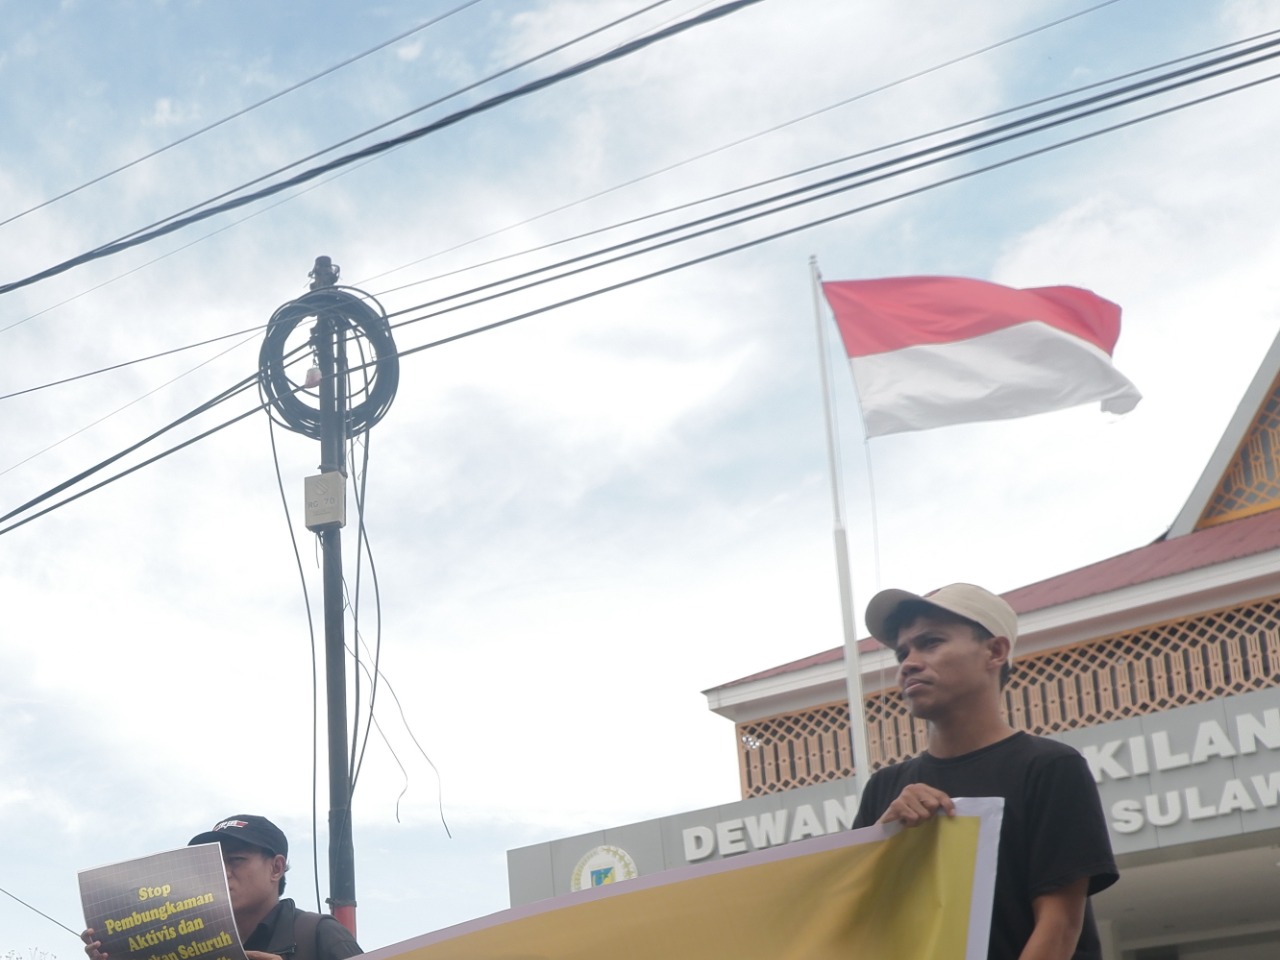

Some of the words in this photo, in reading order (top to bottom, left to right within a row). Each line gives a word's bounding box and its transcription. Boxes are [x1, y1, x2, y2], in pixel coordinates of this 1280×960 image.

[682, 795, 858, 863] DEWAN
[138, 884, 171, 901] Stop
[105, 892, 214, 935] Pembungkaman
[128, 925, 177, 952] Aktivis
[178, 917, 205, 936] dan
[177, 930, 233, 960] Seluruh
